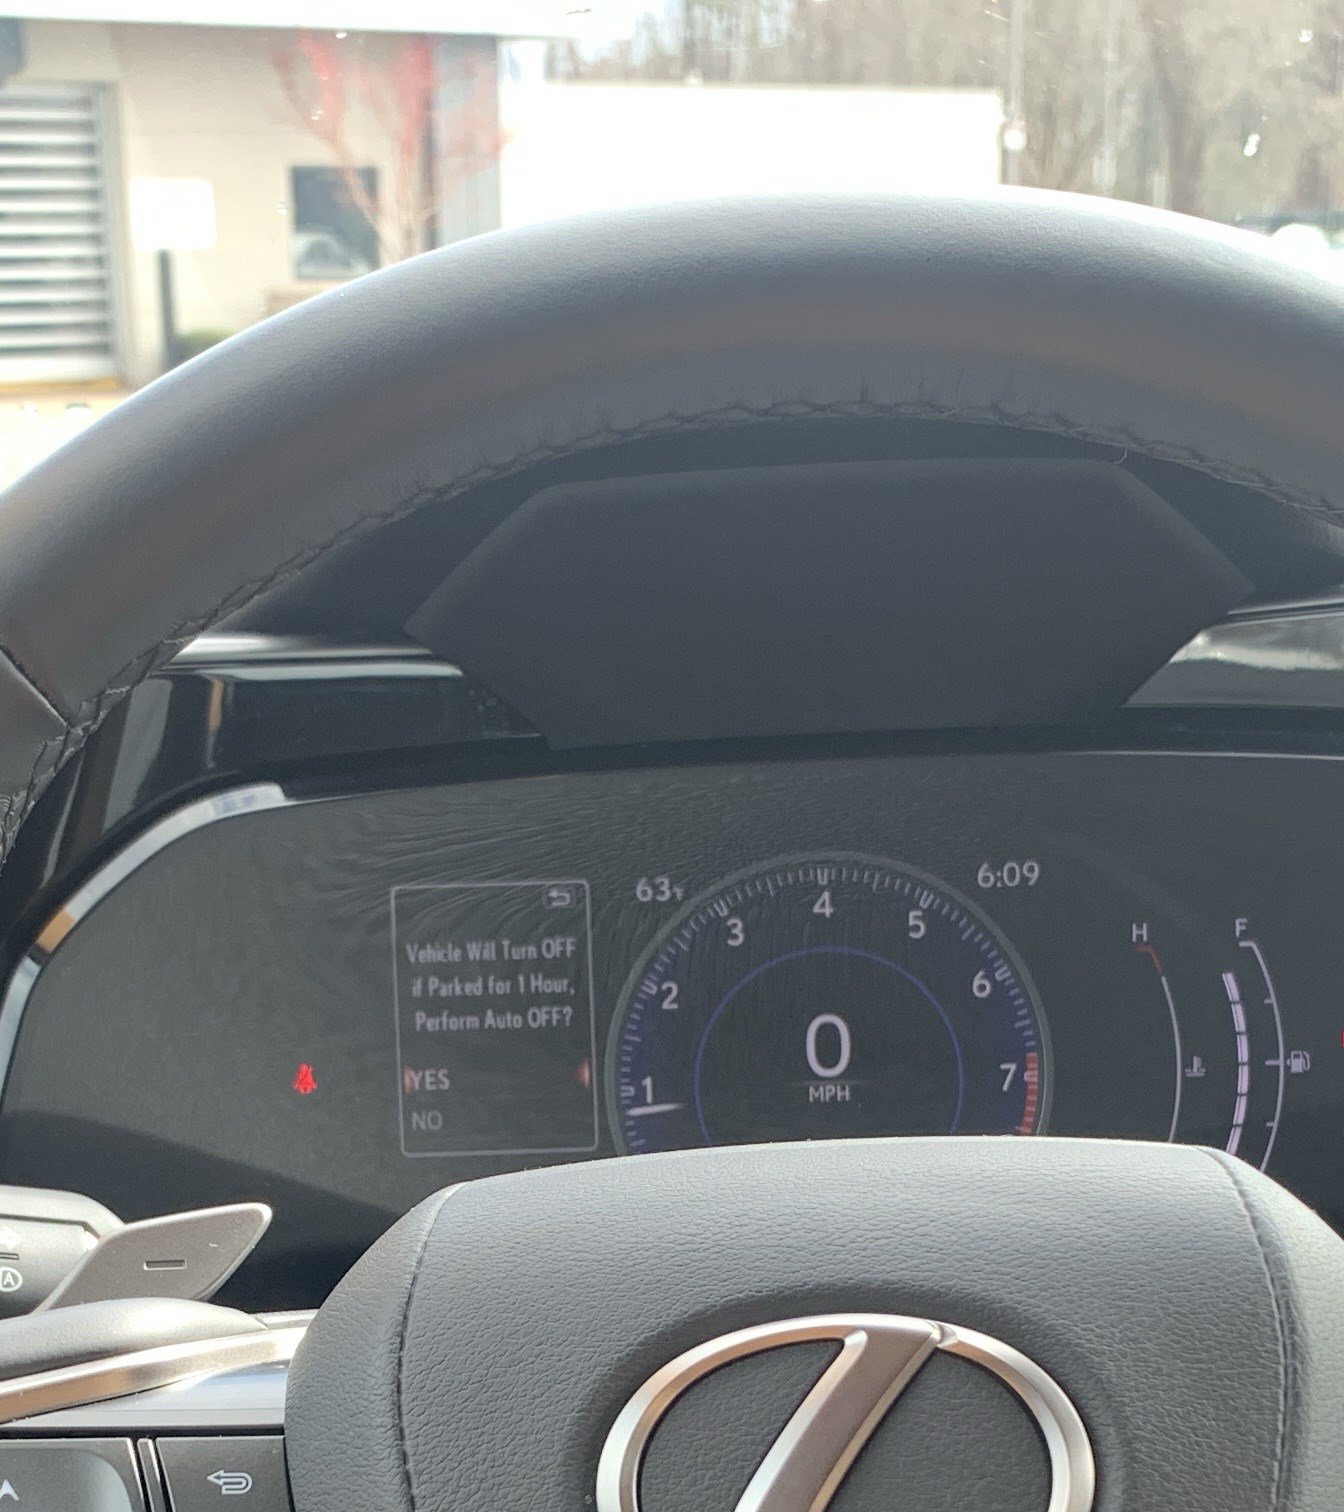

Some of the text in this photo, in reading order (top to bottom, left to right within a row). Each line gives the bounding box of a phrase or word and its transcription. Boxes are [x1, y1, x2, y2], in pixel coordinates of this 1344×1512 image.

[976, 861, 1041, 888] 6:09
[812, 889, 834, 918] 4
[726, 917, 745, 947] 3
[907, 911, 926, 939] 5
[1131, 922, 1148, 944] H
[1234, 918, 1249, 938] F
[406, 936, 577, 963] Vehicle Will Turn OFF
[412, 977, 422, 997] if
[428, 974, 483, 997] Parked
[488, 974, 512, 996] for
[518, 973, 526, 994] 1
[660, 981, 679, 1010] 2
[971, 971, 992, 999] 6
[415, 1005, 574, 1032] Perform Auto OFF?
[806, 1012, 851, 1078] 0
[411, 1068, 450, 1091] YES
[641, 1076, 654, 1104] 1
[999, 1062, 1017, 1092] 7
[809, 1084, 850, 1103] MPH
[411, 1109, 443, 1131] NO
